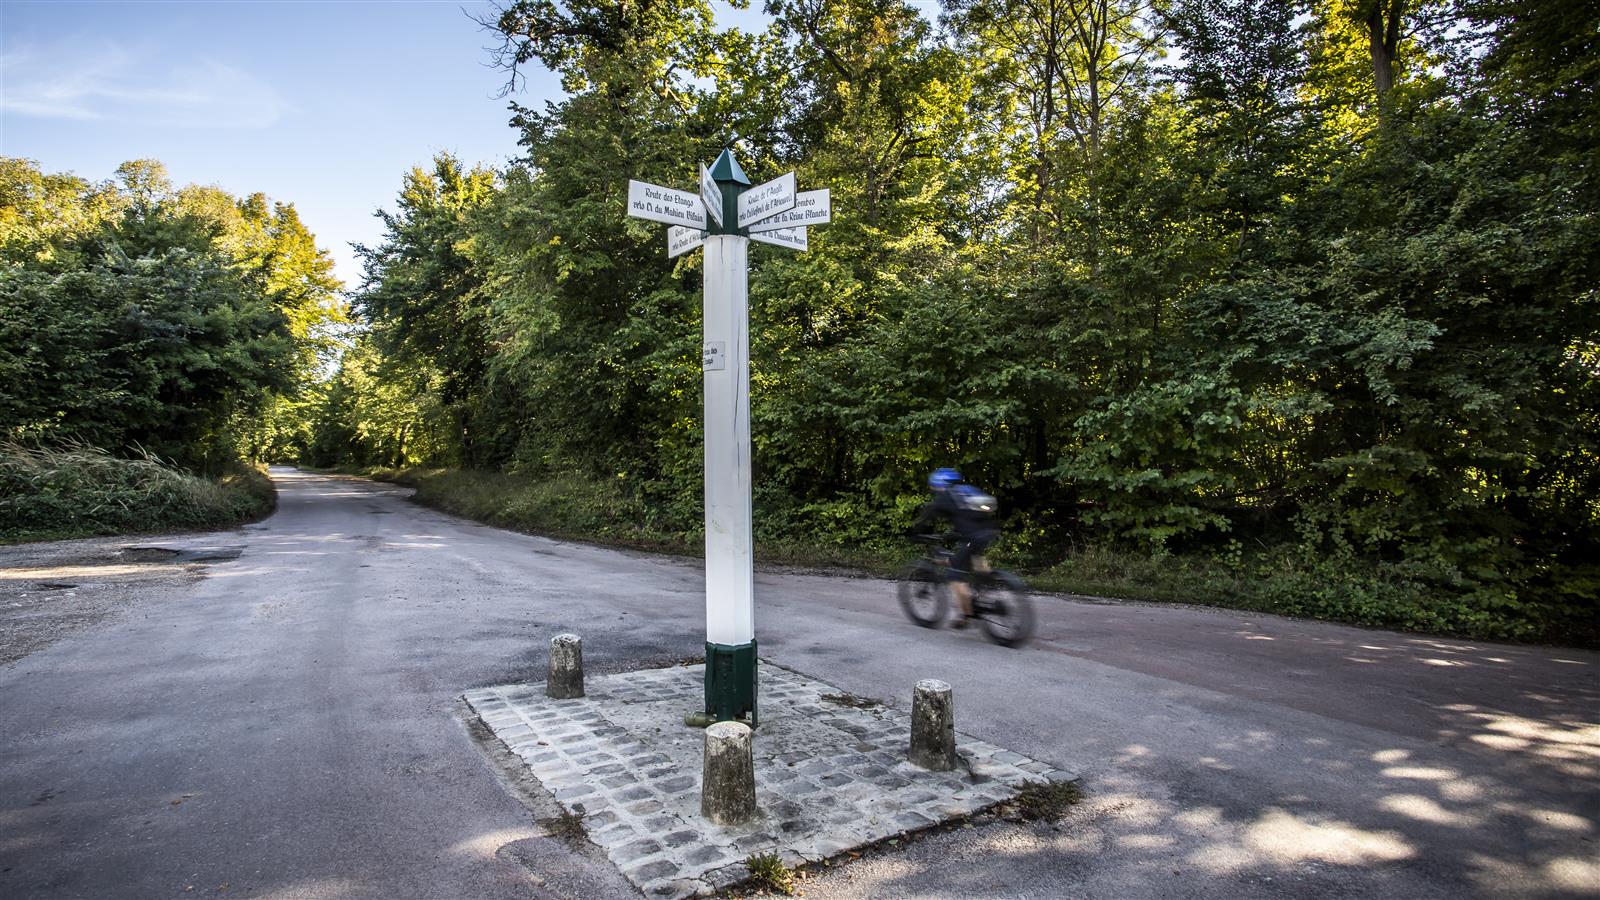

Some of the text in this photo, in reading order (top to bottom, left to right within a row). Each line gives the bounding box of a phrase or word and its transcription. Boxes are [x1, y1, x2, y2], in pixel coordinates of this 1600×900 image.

[645, 187, 661, 200] Route
[664, 192, 672, 202] des
[675, 194, 694, 208] Etangs
[761, 190, 766, 200] de
[655, 204, 663, 214] du
[774, 213, 780, 223] de
[781, 213, 788, 222] la
[790, 211, 804, 222] Reine
[805, 208, 828, 219] Blanche
